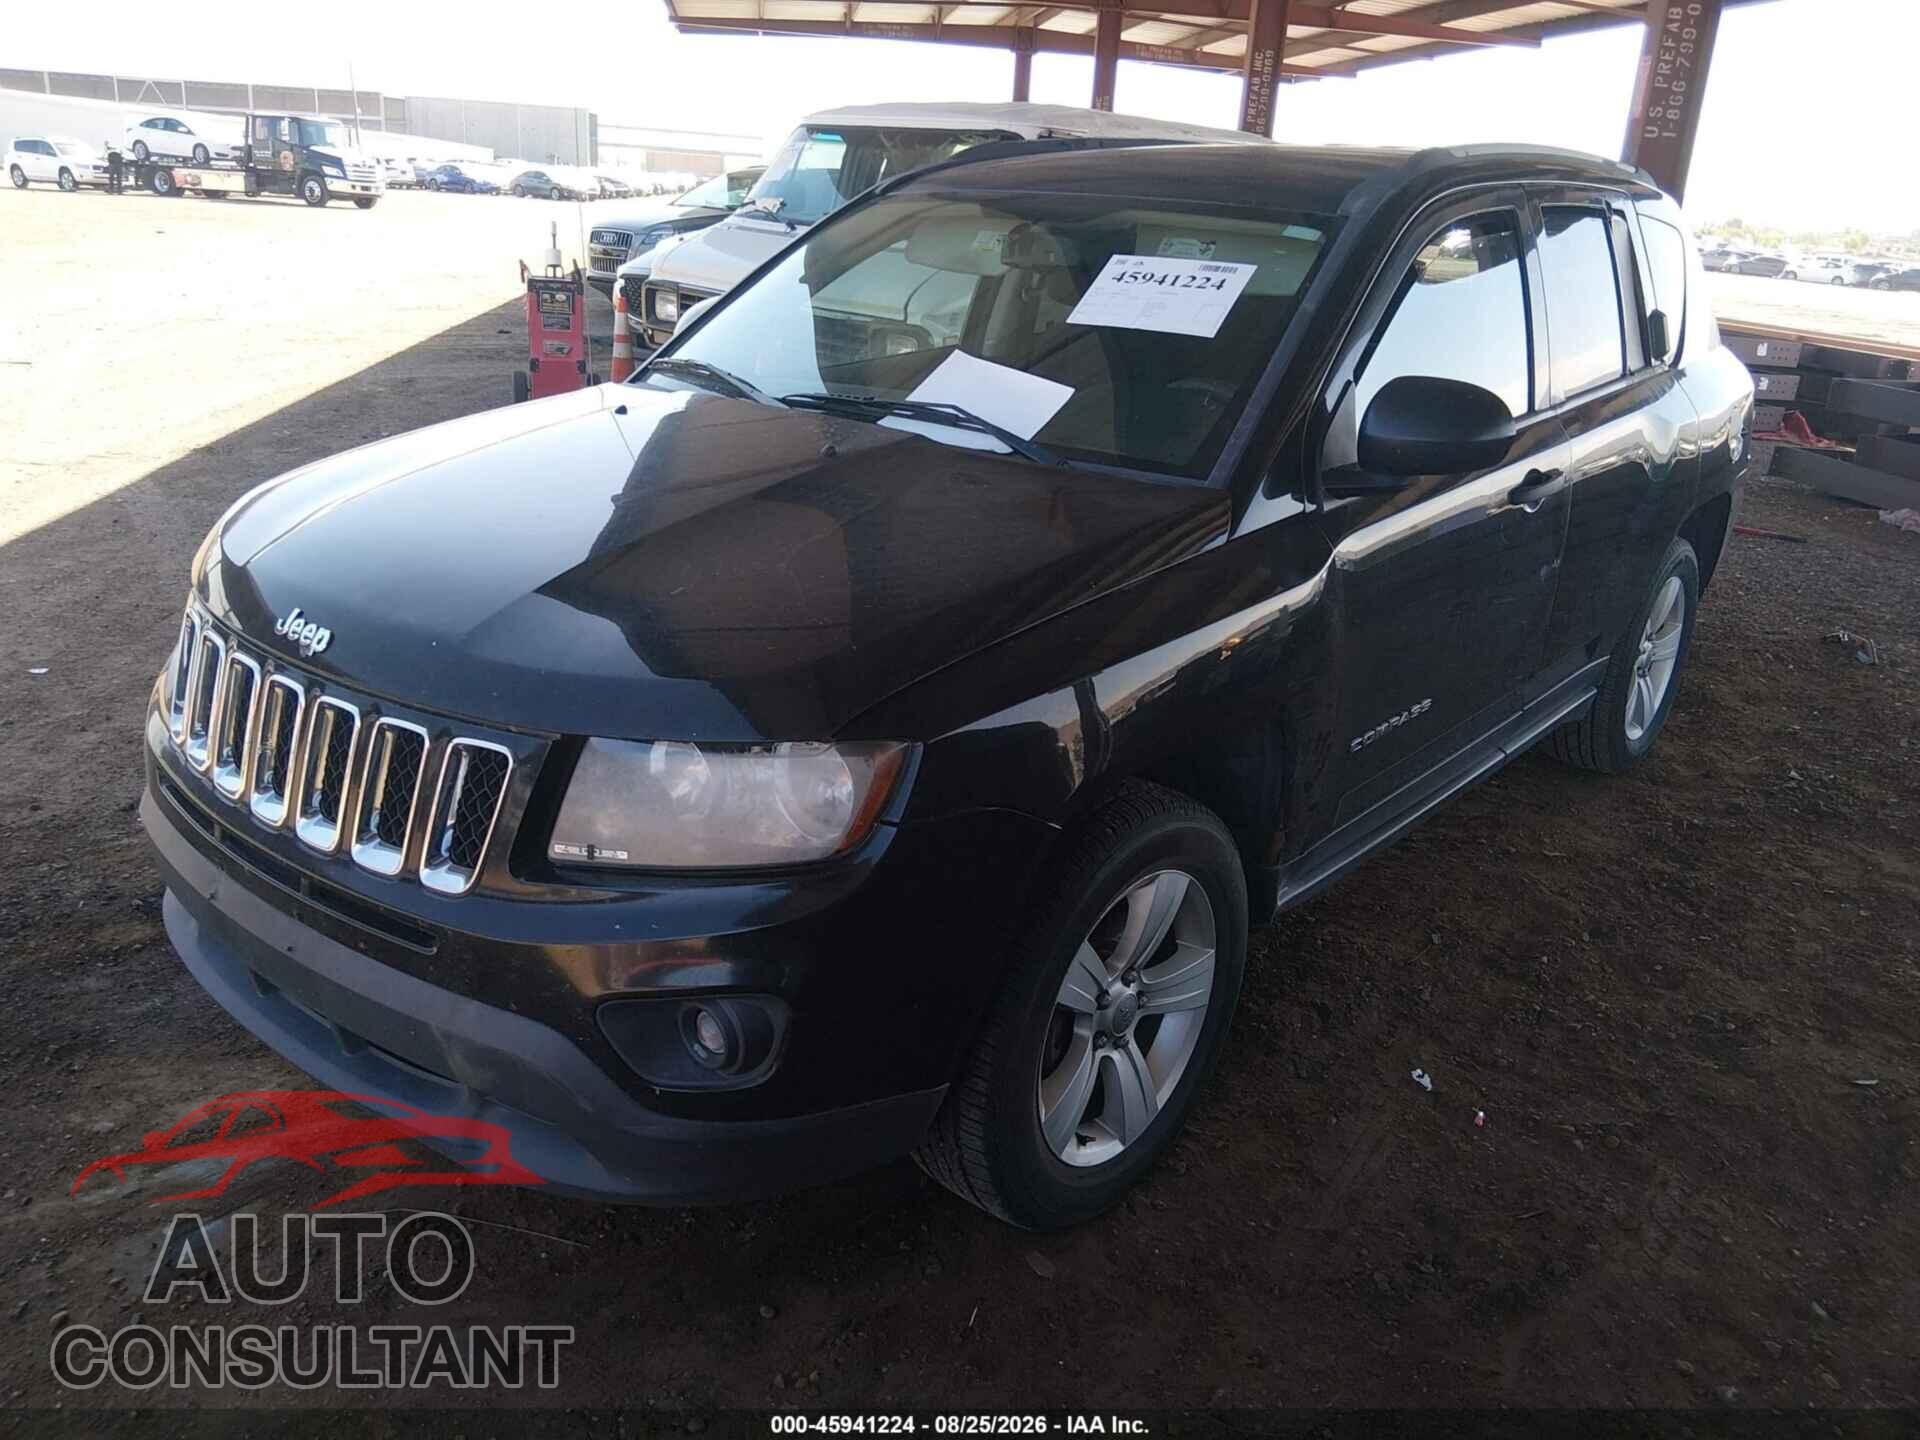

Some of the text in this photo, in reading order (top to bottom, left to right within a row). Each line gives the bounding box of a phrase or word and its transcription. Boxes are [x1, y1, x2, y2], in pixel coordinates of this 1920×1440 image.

[1643, 7, 1682, 138] U.S. PREFAB
[1112, 270, 1227, 291] 45941224
[274, 607, 332, 657] Jeep
[1351, 698, 1432, 752] COMPASS
